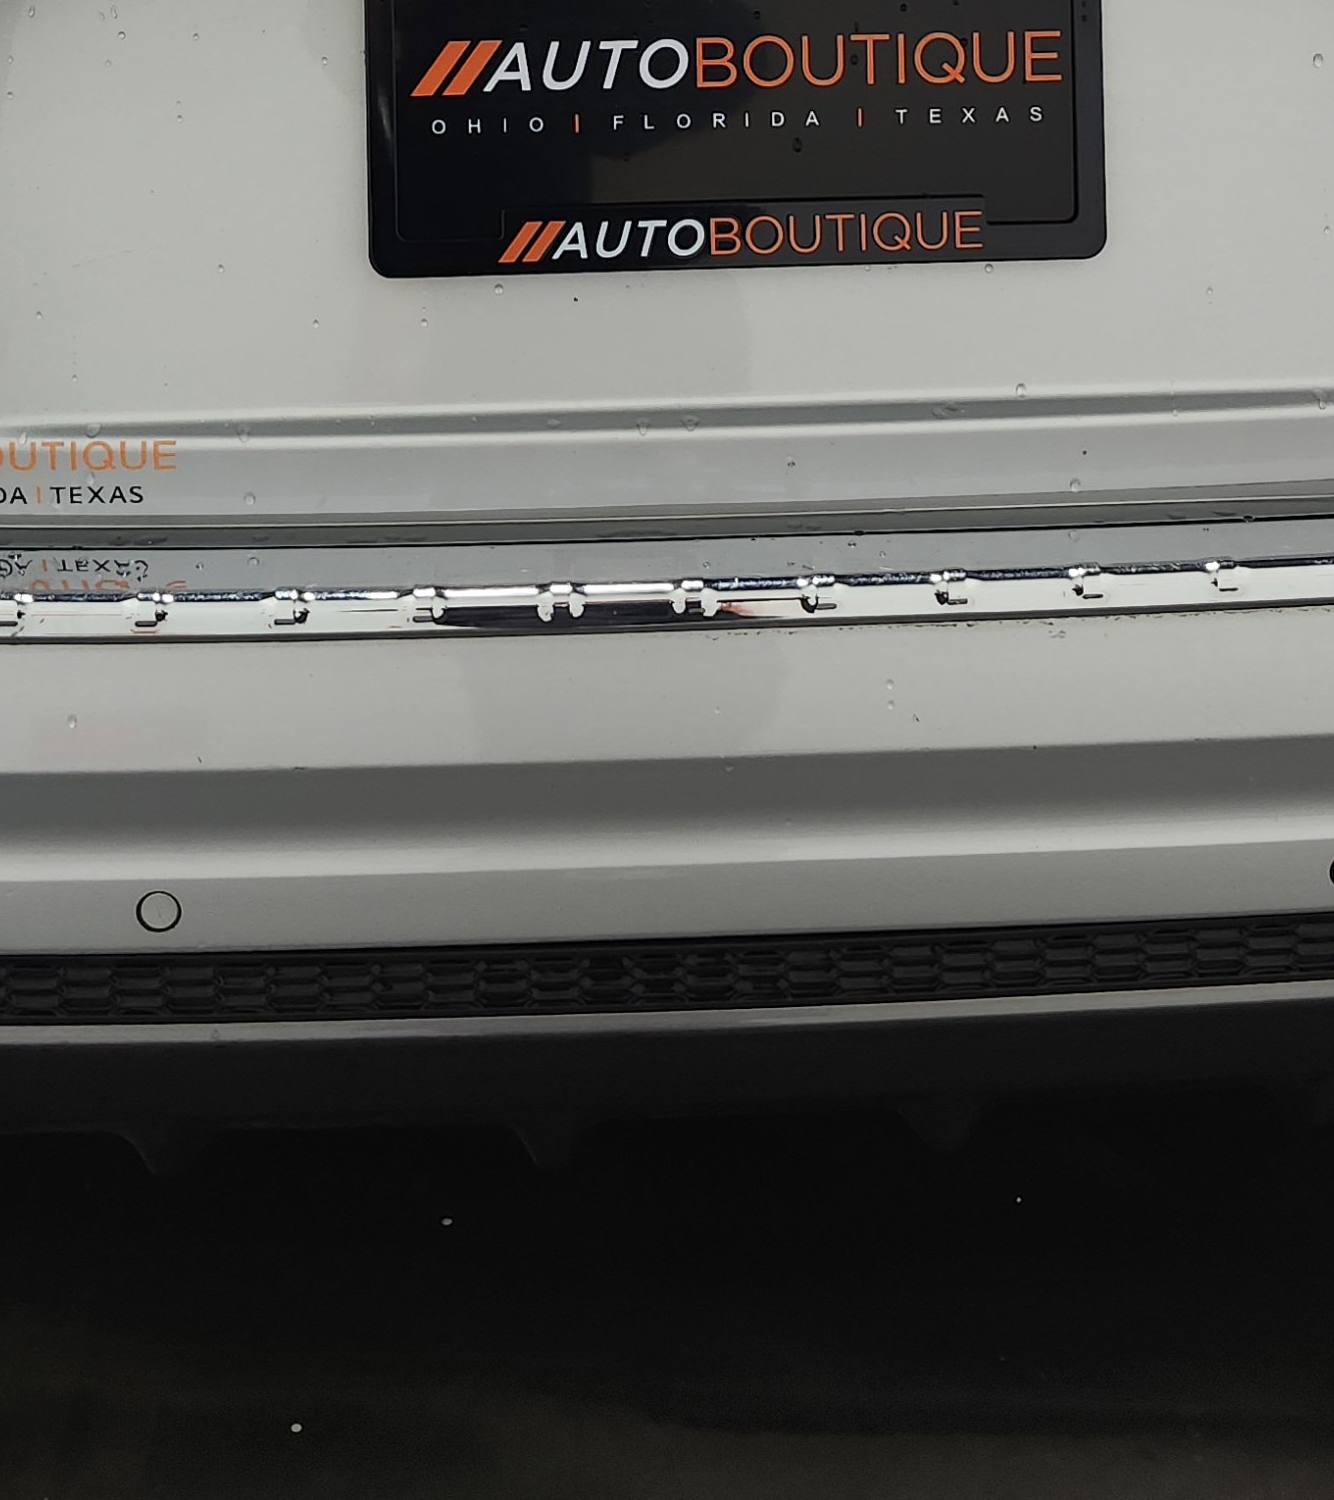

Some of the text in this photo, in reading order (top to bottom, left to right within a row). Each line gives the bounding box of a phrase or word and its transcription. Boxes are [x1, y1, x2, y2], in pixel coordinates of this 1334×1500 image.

[483, 30, 1063, 93] AUTOBOUTIQUE
[430, 105, 1044, 136] OHIO FLORIDA TEXAS
[552, 209, 985, 260] AUTOBOUTIQUE
[51, 485, 145, 505] TEXAS
